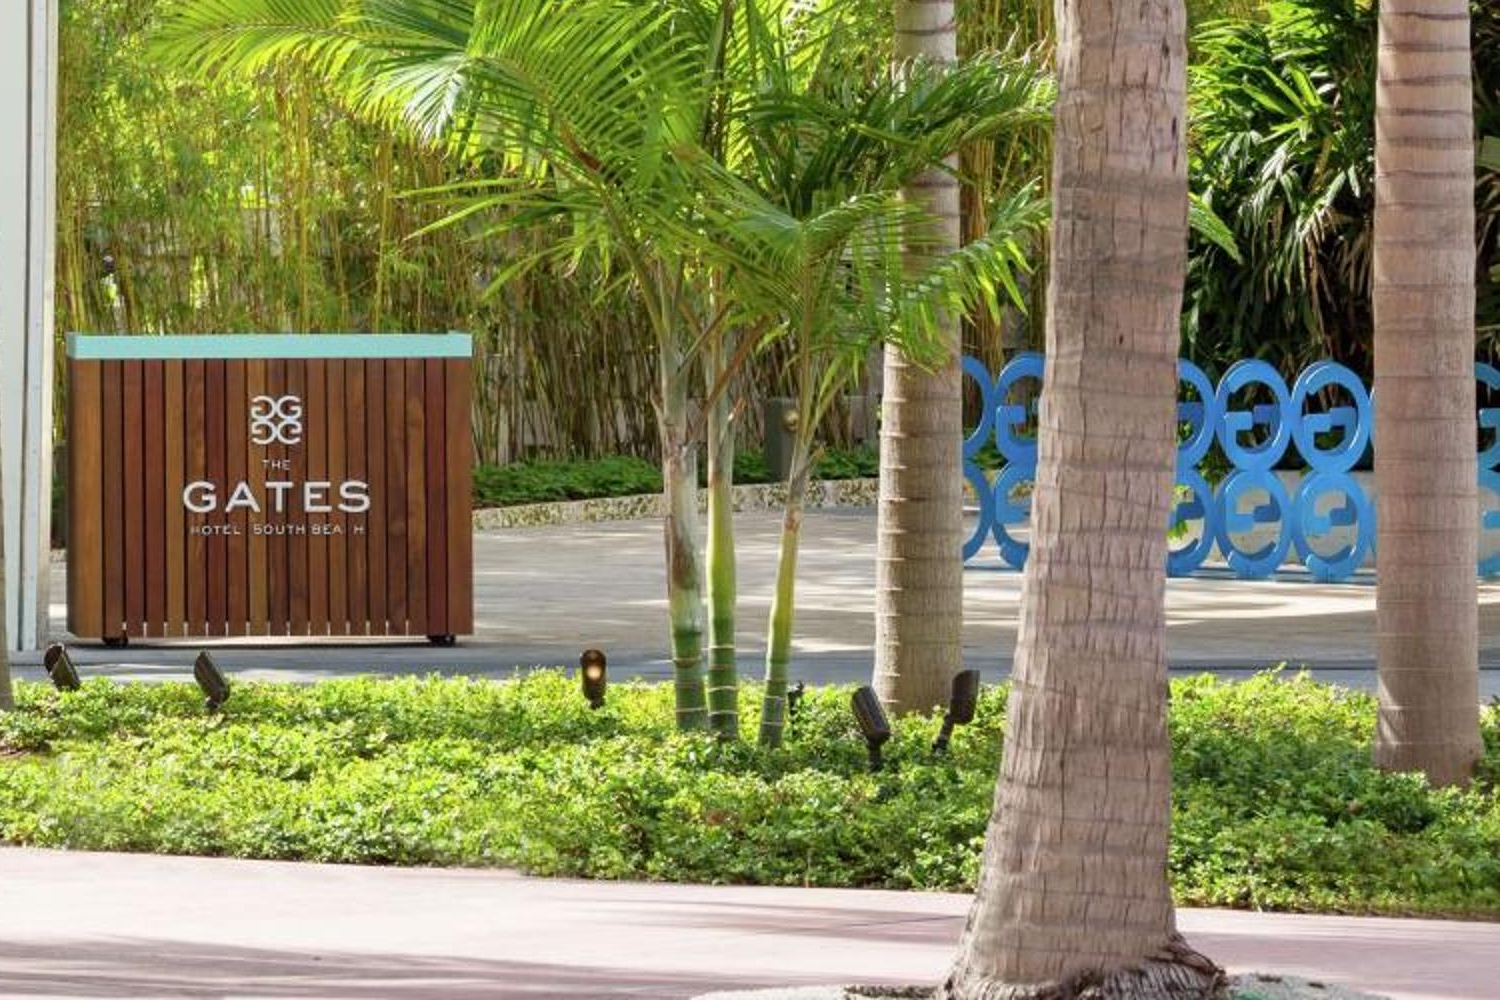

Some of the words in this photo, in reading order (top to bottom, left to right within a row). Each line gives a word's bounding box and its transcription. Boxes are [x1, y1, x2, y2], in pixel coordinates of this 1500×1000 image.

[262, 459, 291, 471] THE
[183, 480, 371, 513] GATES
[253, 524, 306, 535] SOUTH
[311, 524, 365, 535] BEAH
